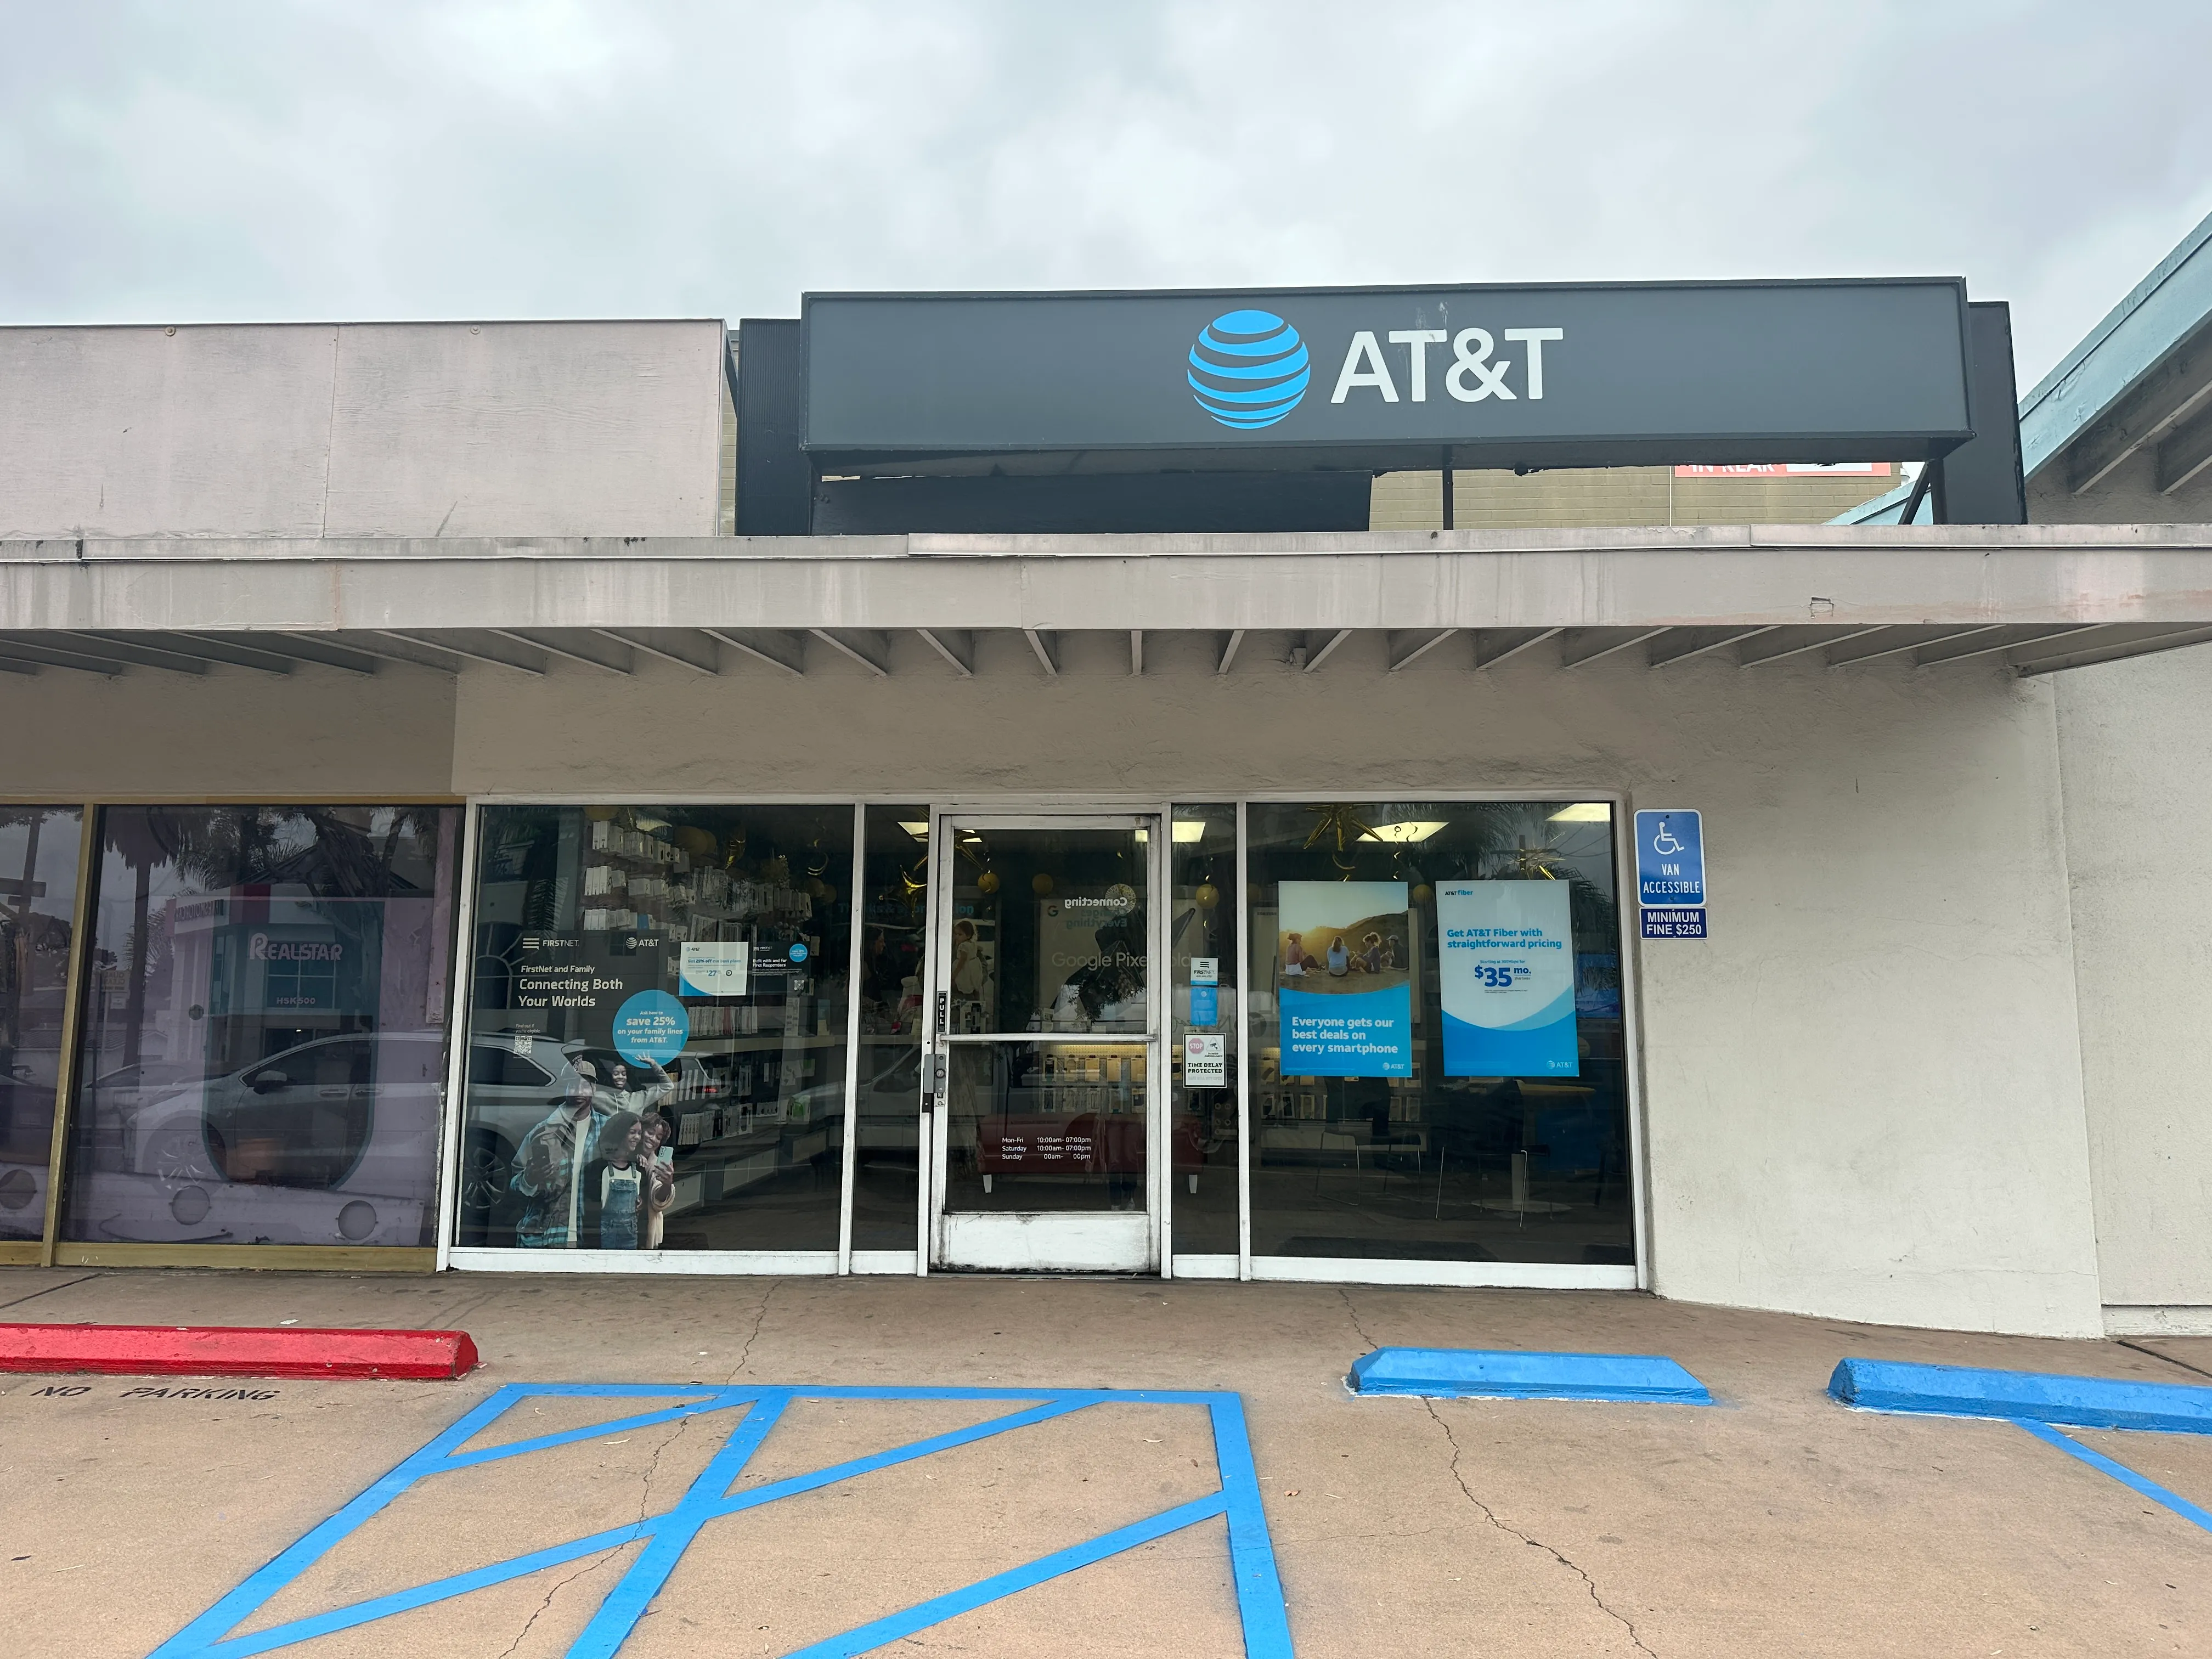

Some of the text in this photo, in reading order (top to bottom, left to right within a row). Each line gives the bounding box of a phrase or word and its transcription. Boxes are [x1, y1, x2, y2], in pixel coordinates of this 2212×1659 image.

[1330, 328, 1564, 403] AT&T
[1661, 864, 1679, 876] VAN
[1643, 881, 1700, 894] ACCESSIBLE
[1647, 912, 1700, 923] MINIMUM
[1466, 929, 1491, 937] AT&T
[1520, 928, 1543, 936] with
[1646, 923, 1702, 936] FINE $250
[542, 939, 579, 947] FIRSTNET
[639, 939, 659, 947] AT&T
[1447, 939, 1562, 950] straightforward pricing
[1052, 952, 1191, 971] Google Pixe old
[570, 965, 595, 974] Family
[1474, 964, 1513, 988] $35
[520, 978, 623, 992] Connecting Both
[518, 995, 596, 1007] Your Worlds
[626, 1016, 675, 1026] save 25%
[1292, 1017, 1394, 1029] Everyone gets our
[644, 1028, 666, 1036] family
[1292, 1029, 1366, 1040] best deals on
[1292, 1043, 1398, 1055] every smartphone
[30, 1386, 281, 1401] NO PARKING
